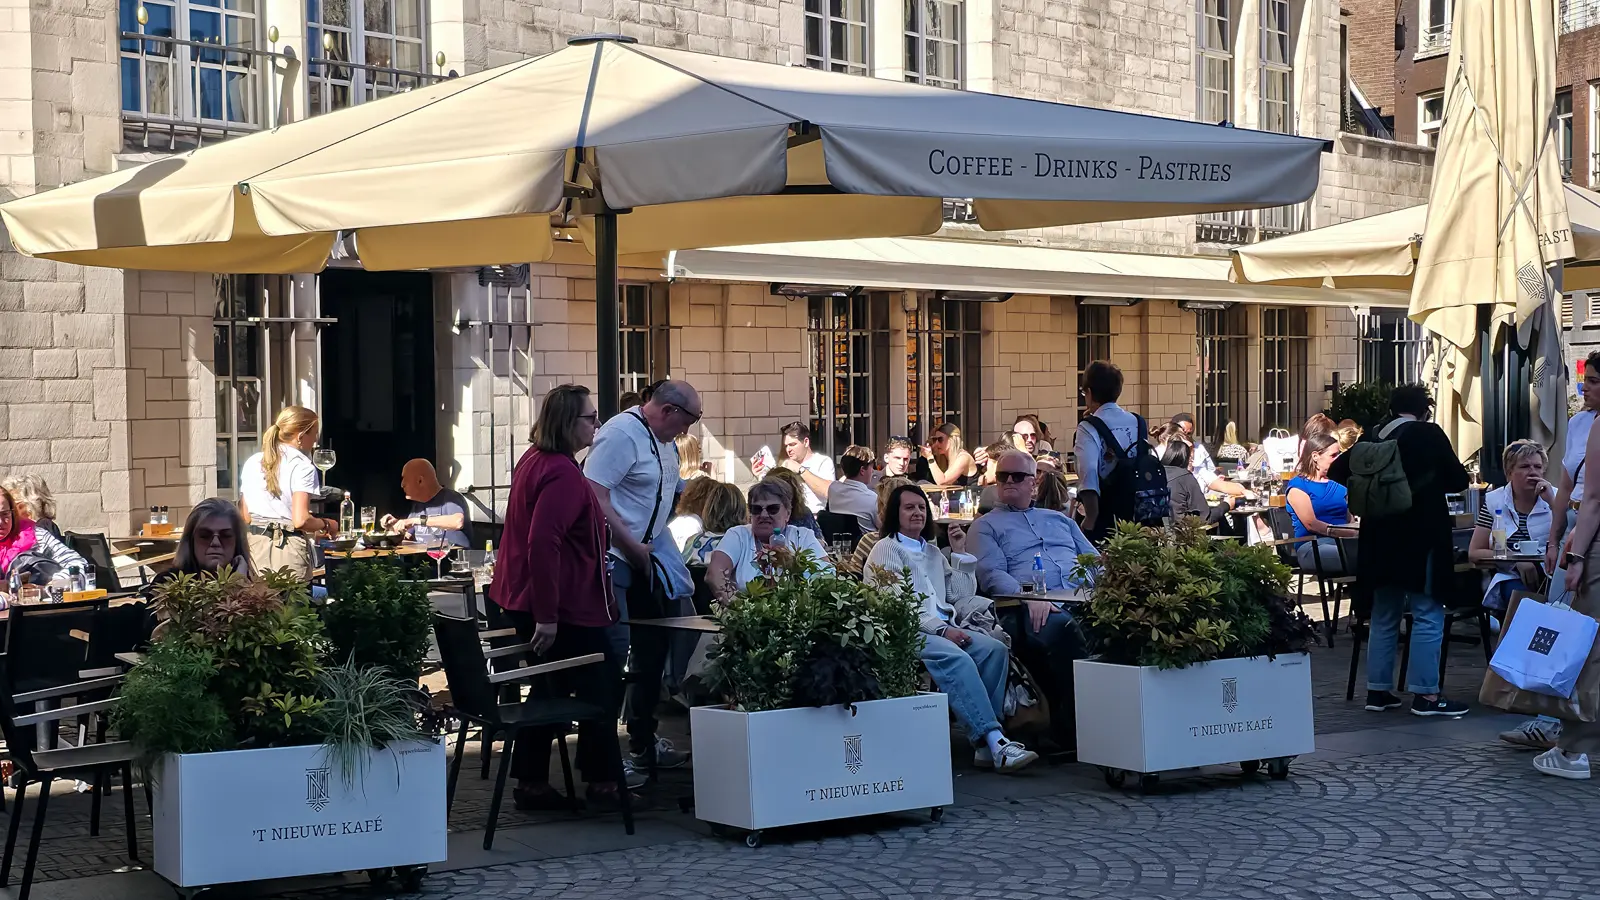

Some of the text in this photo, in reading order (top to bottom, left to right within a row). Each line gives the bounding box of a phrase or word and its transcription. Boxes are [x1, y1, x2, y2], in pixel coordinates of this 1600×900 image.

[928, 149, 1013, 176] COFFEE
[1034, 153, 1117, 179] DRINKS
[1137, 156, 1232, 182] PASTRIES
[1201, 722, 1244, 736] NIEUWE
[1246, 715, 1273, 731] KAFÉ
[820, 784, 869, 800] NIEUWE
[873, 776, 904, 793] KAFÉ
[271, 823, 337, 841] NIEUWE
[341, 815, 383, 835] KAFÉ
